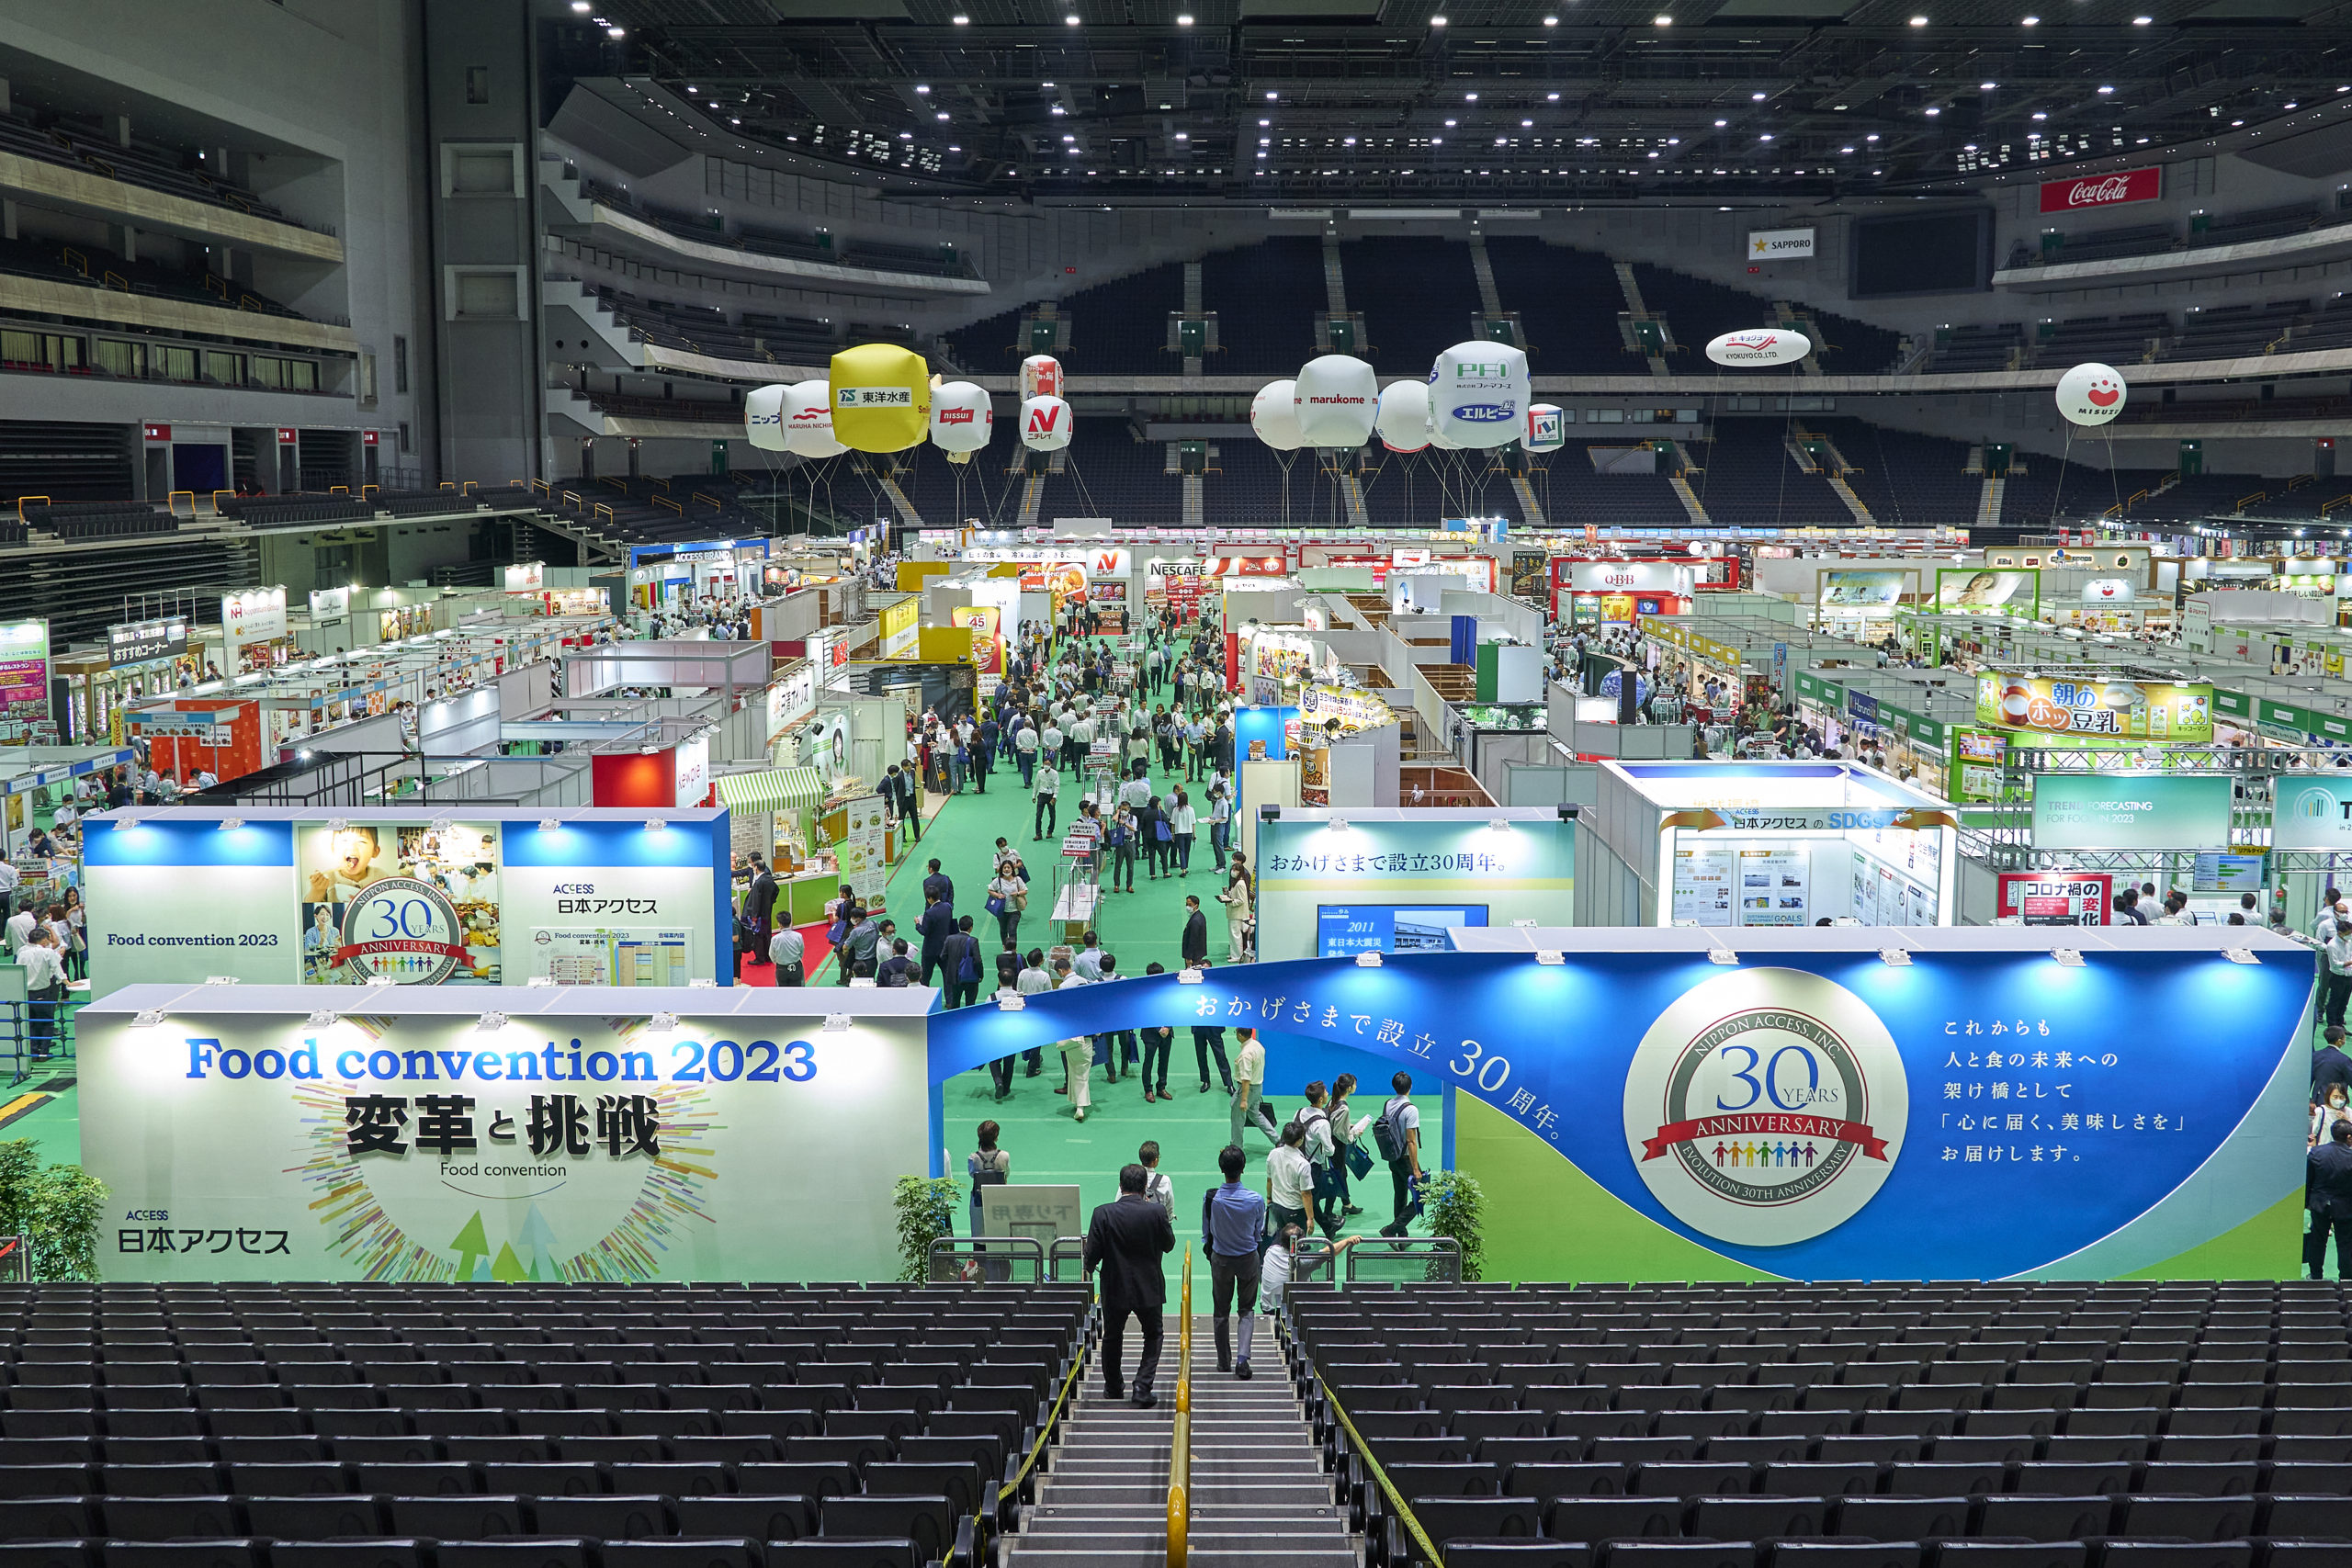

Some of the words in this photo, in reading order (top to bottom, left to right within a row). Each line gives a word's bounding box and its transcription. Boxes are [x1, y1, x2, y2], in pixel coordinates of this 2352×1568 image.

[2069, 175, 2132, 205] Coca-Cola
[1772, 239, 1811, 250] SAPPORO
[1457, 363, 1507, 378] PFI
[862, 391, 910, 403] 東洋水産
[1310, 394, 1365, 404] marukome
[944, 412, 970, 420] nissui
[1462, 408, 1510, 420] エルビー
[674, 552, 703, 562] ACCESS
[704, 550, 730, 561] BRAND
[1150, 558, 1206, 576] NESCAFÉ
[969, 617, 984, 627] 45
[113, 642, 168, 661] おすすめコーナー
[781, 682, 809, 718] 日清オイリオ
[2052, 683, 2097, 707] 朝の
[1854, 696, 1871, 715] Haruna
[2031, 700, 2068, 728] ホッ
[2071, 708, 2121, 733] 豆乳
[677, 763, 701, 791] kewpie
[2047, 801, 2083, 810] TREND
[2088, 801, 2153, 811] FORECASTING
[1734, 818, 1807, 829] 日本アクセス
[1814, 818, 1823, 829] の
[1829, 813, 1883, 829] SDGs
[2046, 815, 2064, 823] FOR
[2067, 815, 2096, 823] FOO
[2112, 814, 2134, 823] 2023
[1271, 852, 1505, 873] おかげさまで設立30周年。
[356, 881, 390, 907] NIPPON
[390, 879, 425, 897] ACCESS,
[427, 890, 444, 908] INC.
[553, 884, 594, 894] ACCESS
[559, 898, 658, 914] 日本アクセス
[371, 898, 433, 939] 30
[1347, 921, 1374, 932] 2011
[1774, 915, 1803, 923] GOALS
[411, 924, 445, 934] YEARS
[107, 932, 145, 946] Food
[148, 933, 235, 947] convention
[238, 934, 278, 947] 2023
[360, 940, 449, 954] ANNIVERSARY
[1328, 937, 1382, 947] 東日本大震災
[1944, 1020, 2051, 1036] これからも
[1694, 1018, 1749, 1057] NIPPON
[1755, 1014, 1810, 1037] ACCESS,
[1814, 1031, 1840, 1059] INC.
[186, 1037, 322, 1079] Food
[336, 1038, 658, 1080] convention
[671, 1040, 817, 1083] 2023
[1943, 1051, 2118, 1068] 人と食の未来への
[1716, 1045, 1818, 1111] 30
[1783, 1088, 1838, 1102] YEARS
[1943, 1082, 2072, 1100] 架け橋として
[345, 1093, 661, 1156] 変革と挑戦
[1696, 1115, 1845, 1137] ANNIVERSARY
[1941, 1112, 2184, 1131] 「心に届く、美味しさを」
[1940, 1145, 2081, 1162] お届けします。
[440, 1163, 478, 1177] Food
[484, 1163, 567, 1177] convention
[1682, 1145, 1740, 1194] EVOLUTION
[1742, 1187, 1773, 1199] 30TH
[1777, 1145, 1848, 1198] ANNIVERSARY
[125, 1210, 168, 1221] ACCESS
[119, 1227, 291, 1255] 日本アクセス
